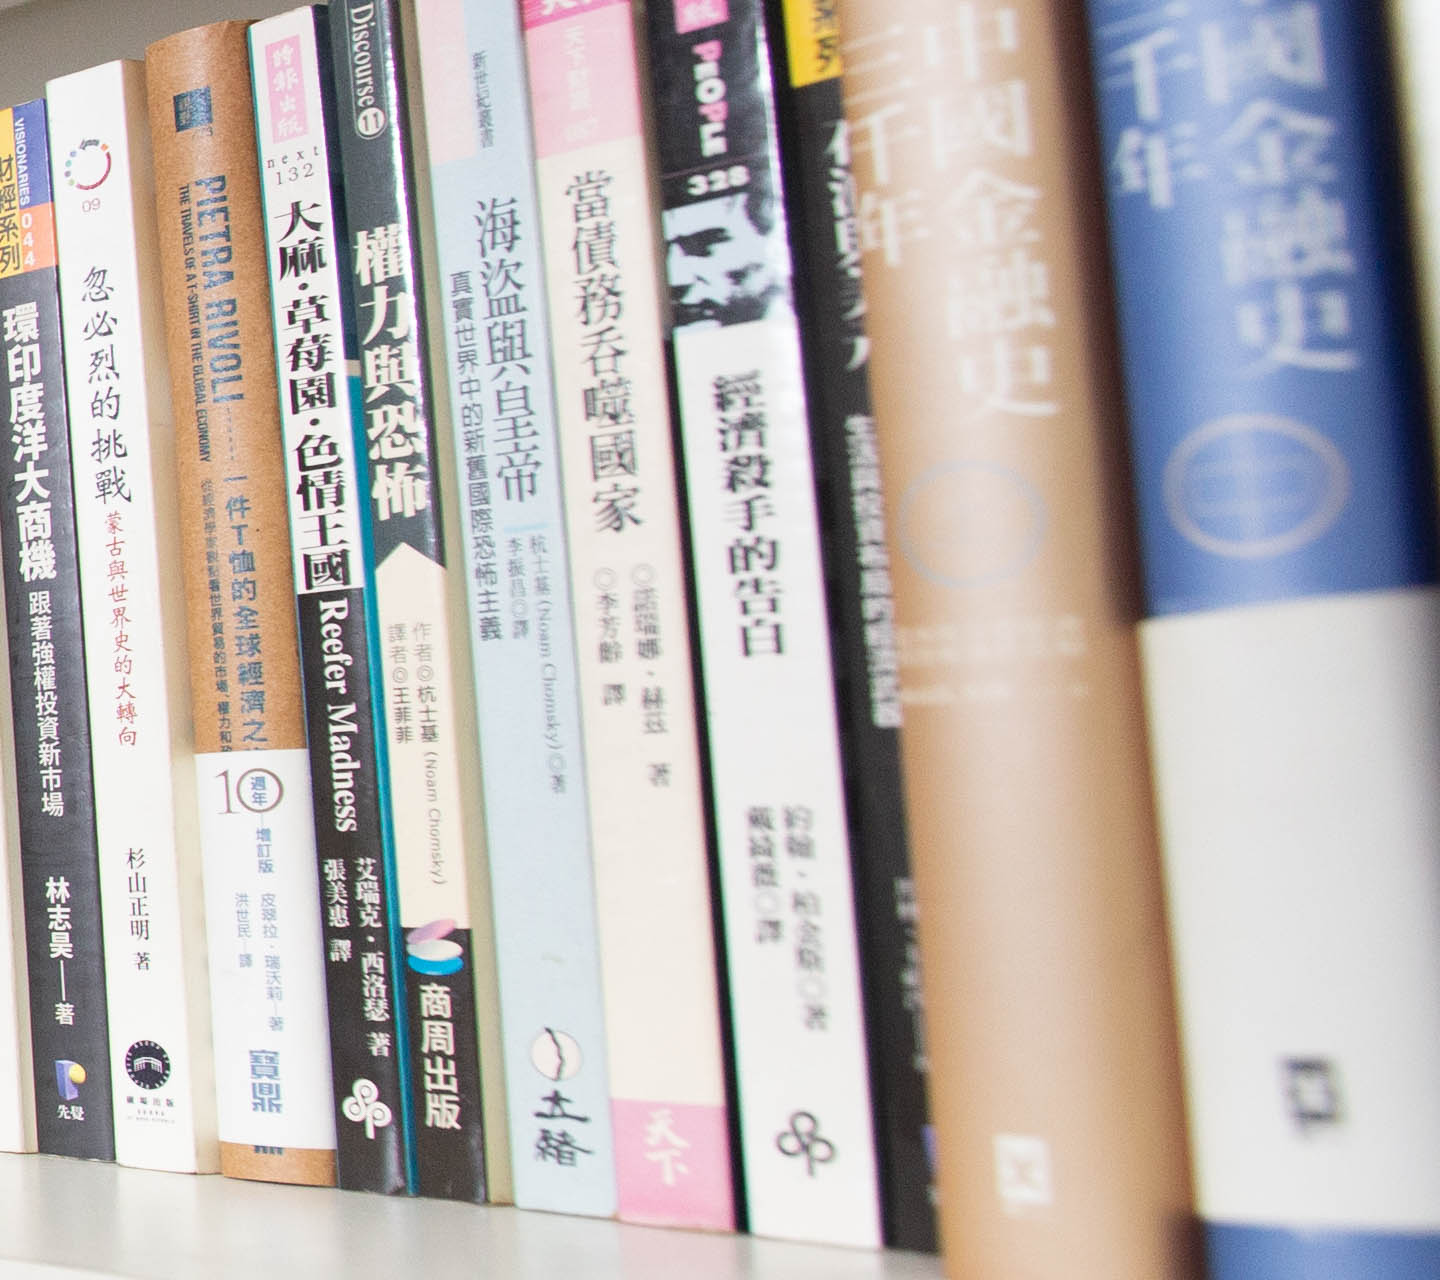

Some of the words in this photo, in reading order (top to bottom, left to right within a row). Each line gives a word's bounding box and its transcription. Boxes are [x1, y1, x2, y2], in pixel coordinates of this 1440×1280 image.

[348, 2, 378, 109] Discourse
[13, 117, 31, 207] VISIONARIES
[81, 197, 103, 214] 09
[266, 145, 321, 170] next
[275, 164, 316, 186] 132
[686, 165, 751, 197] 328
[924, 1, 1063, 421] 中國金融史
[194, 173, 235, 293] PIETRA
[81, 265, 133, 505] 忽必烈的挑戰
[181, 208, 194, 257] TRAVELS
[195, 409, 213, 463] ECONOMY
[205, 299, 245, 404] RIVOLI
[352, 225, 429, 521] 權力與恐怖
[475, 198, 542, 505] 海盜與皇帝
[565, 168, 647, 534] 當債務吞噬國家
[2, 301, 58, 581] 環印度洋大商機
[273, 199, 353, 591] 大麻·草莓園·色情王國
[104, 511, 139, 747] 蒙古與世界史的大轉向
[318, 597, 350, 695] Reefer
[28, 592, 65, 818] 跟著強權投資新市場
[325, 704, 358, 833] Madness
[123, 846, 152, 943] 杉山正明
[323, 857, 350, 929] 張美惠
[56, 1105, 85, 1121] 先覺
[418, 983, 462, 1131] 商周出版
[532, 1087, 594, 1169] 立緒
[643, 1111, 689, 1186] 天下
